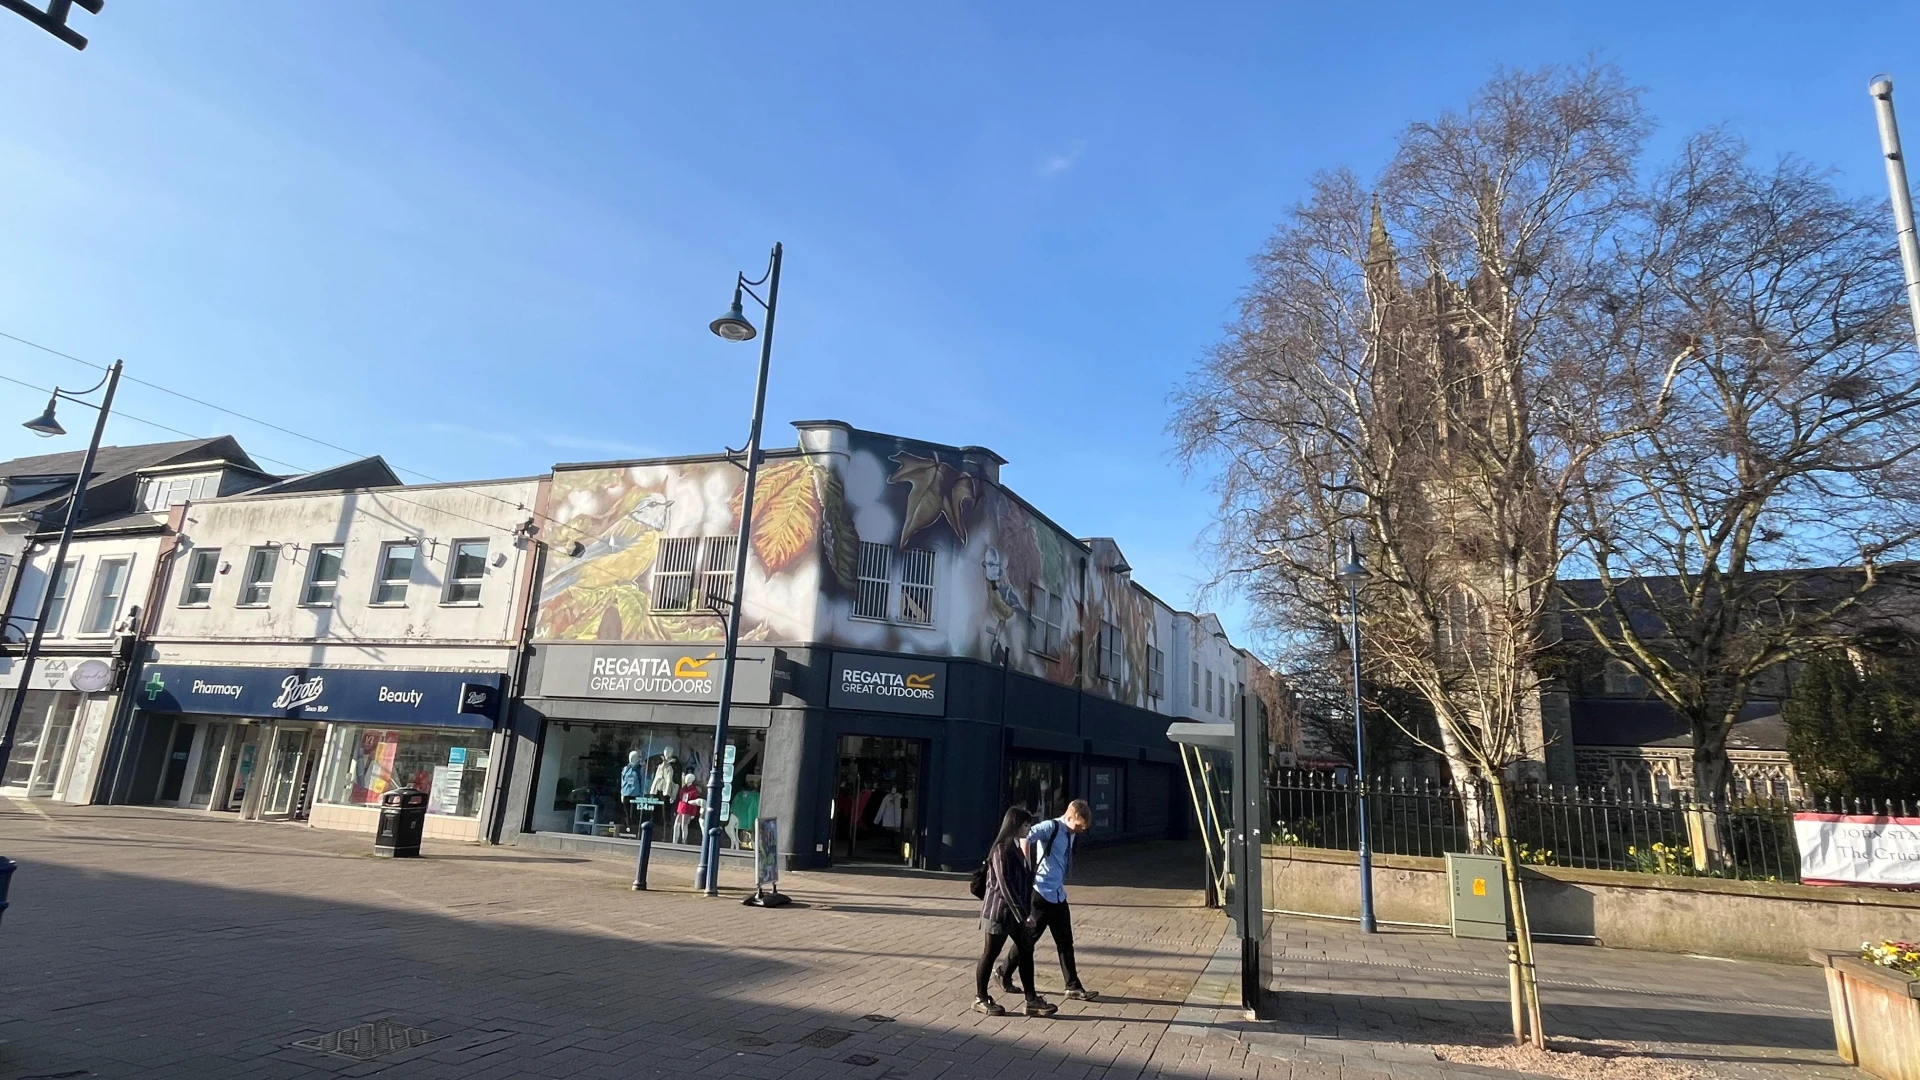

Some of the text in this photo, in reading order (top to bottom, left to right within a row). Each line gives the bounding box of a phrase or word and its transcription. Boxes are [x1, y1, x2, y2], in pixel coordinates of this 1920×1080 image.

[592, 657, 672, 676] REGATTA
[590, 676, 713, 694] GREAT OUTDOORS
[842, 669, 904, 687] REGATTA
[192, 680, 243, 699] Pharmacy
[272, 675, 324, 710] Boots
[379, 686, 424, 708] Beauty
[841, 683, 935, 700] GREAT OUTDOORS
[1842, 828, 1882, 840] JOHN
[1837, 846, 1871, 860] The
